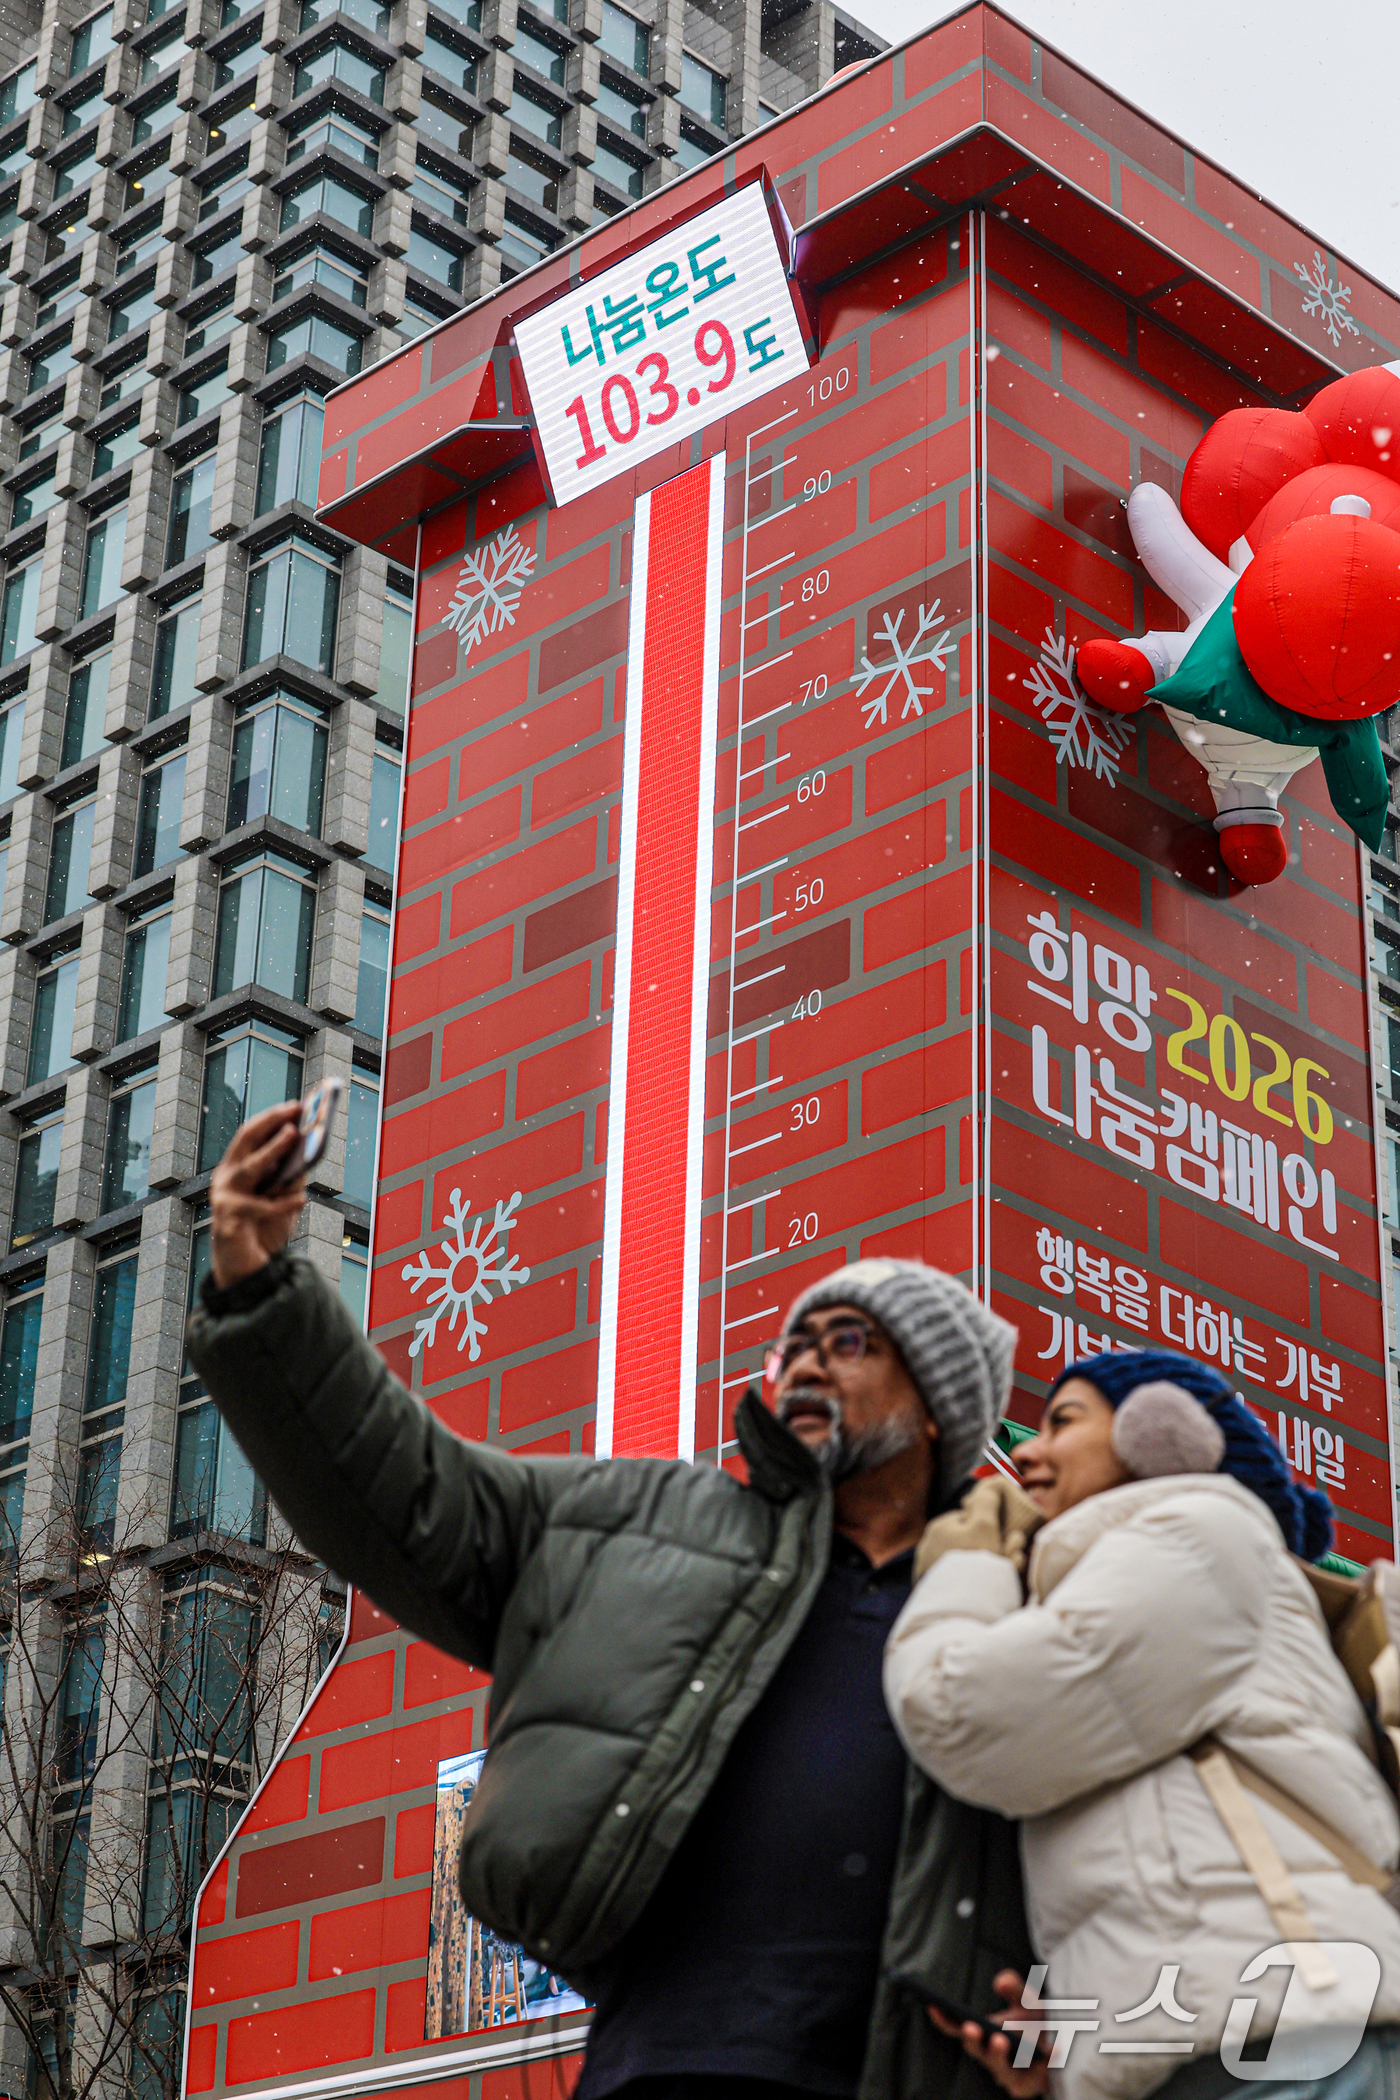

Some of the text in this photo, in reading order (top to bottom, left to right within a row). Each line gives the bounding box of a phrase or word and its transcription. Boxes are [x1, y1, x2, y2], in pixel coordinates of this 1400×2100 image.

[560, 234, 736, 367] 나눔온도
[806, 367, 850, 407] 100
[803, 469, 832, 502] 90
[801, 569, 830, 602] 80
[799, 674, 828, 707] 70
[796, 769, 827, 803] 60
[794, 878, 824, 913] 50
[790, 988, 823, 1022] 40
[1027, 911, 1334, 1145] 희망 2026
[789, 1097, 821, 1133] 30
[1032, 1024, 1340, 1261] 나눔캠페인
[787, 1212, 819, 1248] 20
[1036, 1227, 1344, 1412] 행복을 더하는 기부
[1278, 1411, 1346, 1491] 내일
